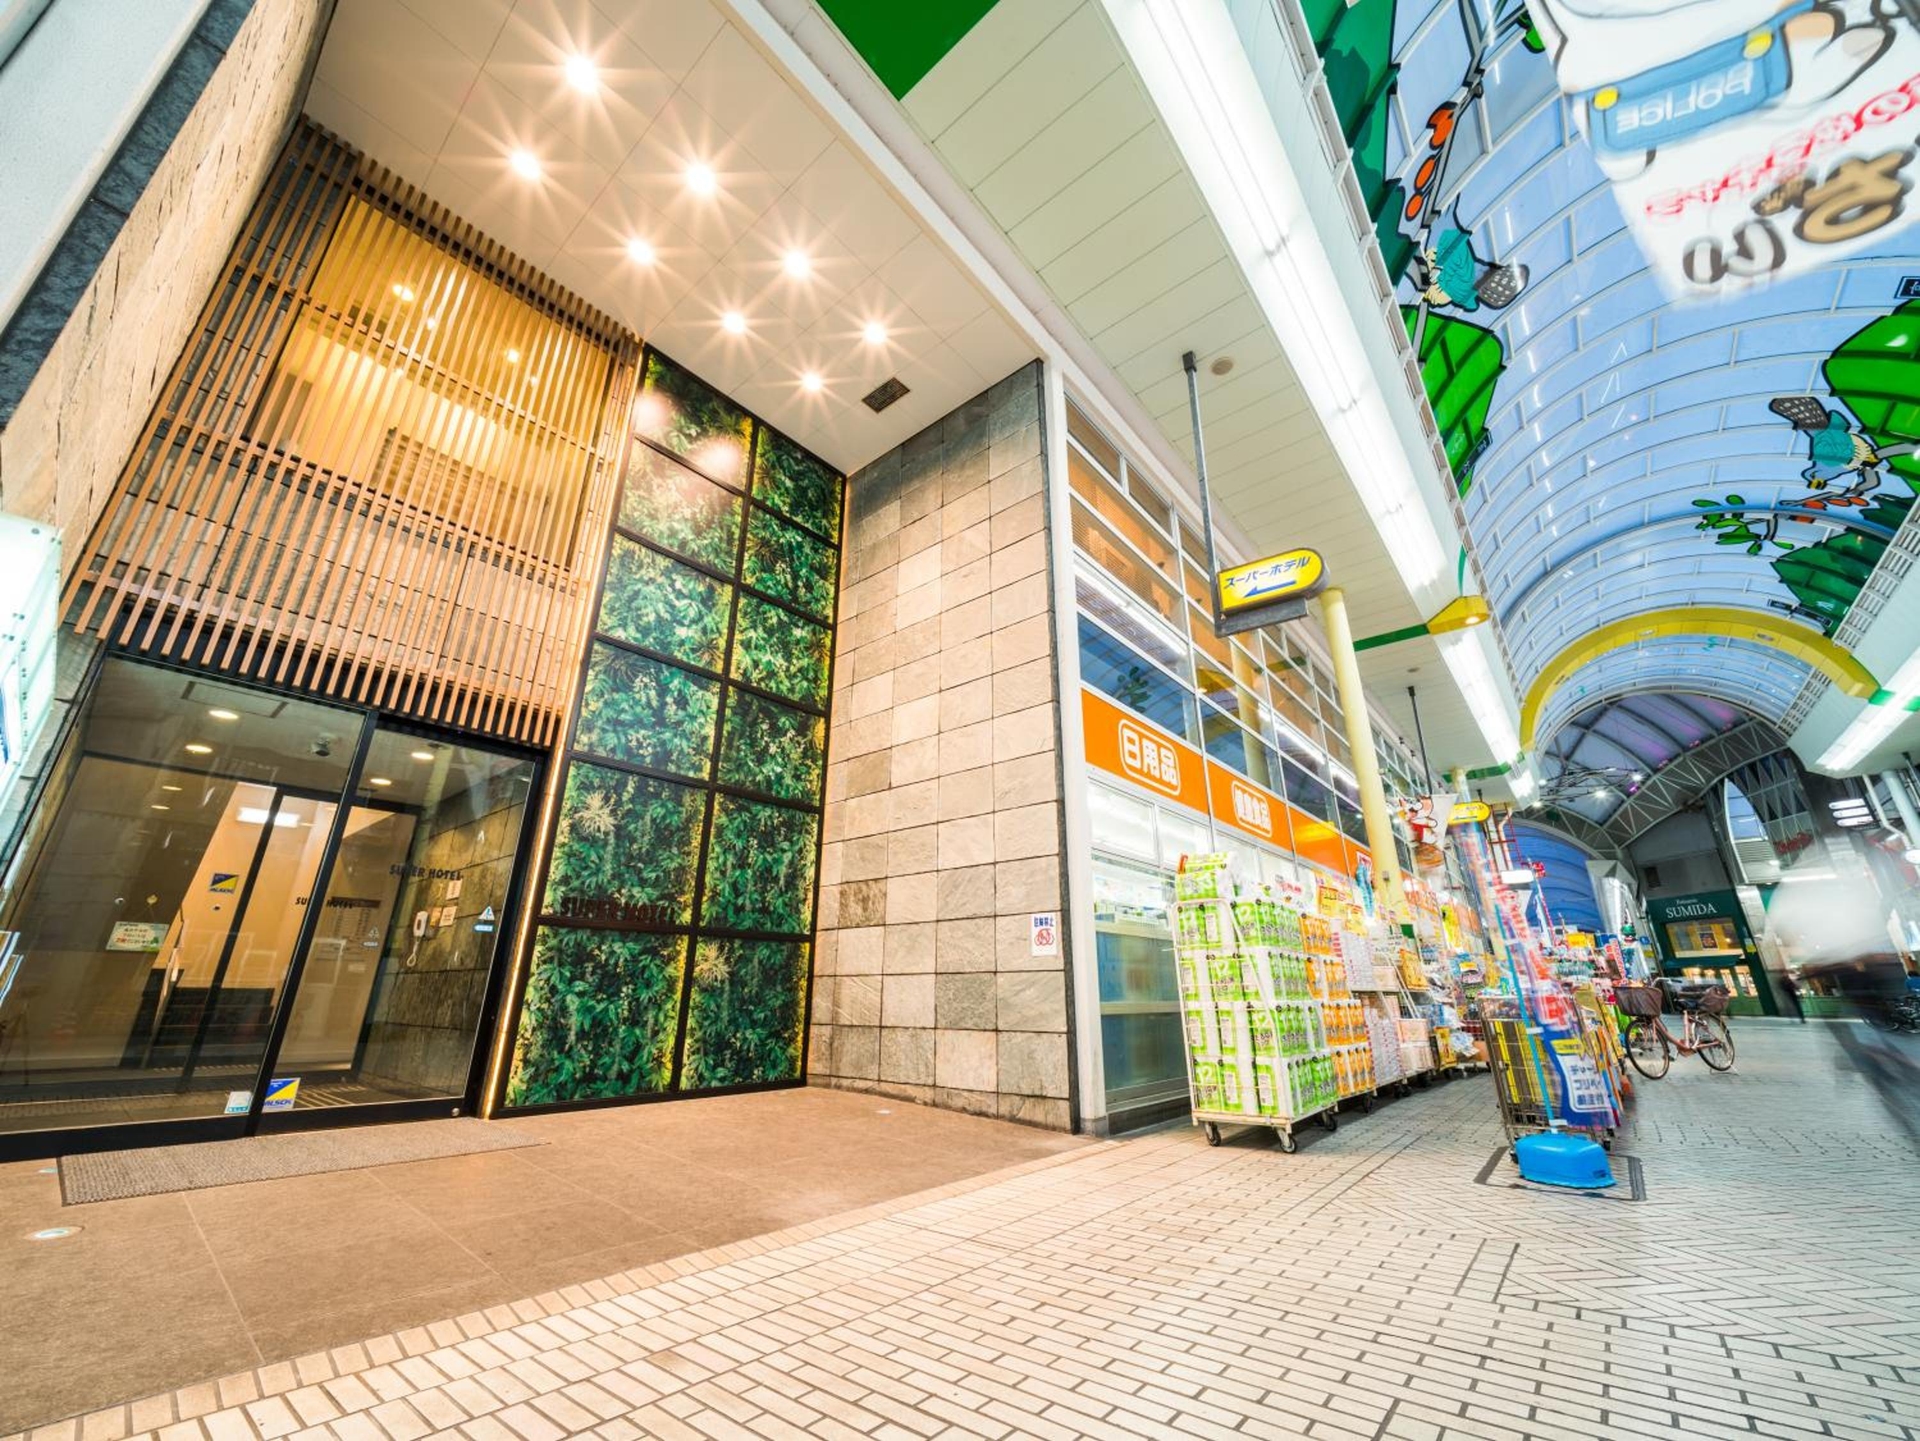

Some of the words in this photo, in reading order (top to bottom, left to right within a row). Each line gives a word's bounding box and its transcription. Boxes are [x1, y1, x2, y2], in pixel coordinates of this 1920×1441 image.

[1223, 556, 1311, 589] スーパーホテル
[1121, 727, 1178, 786] 日用品
[429, 869, 464, 881] HOTEL
[1666, 903, 1717, 919] SUMIDA
